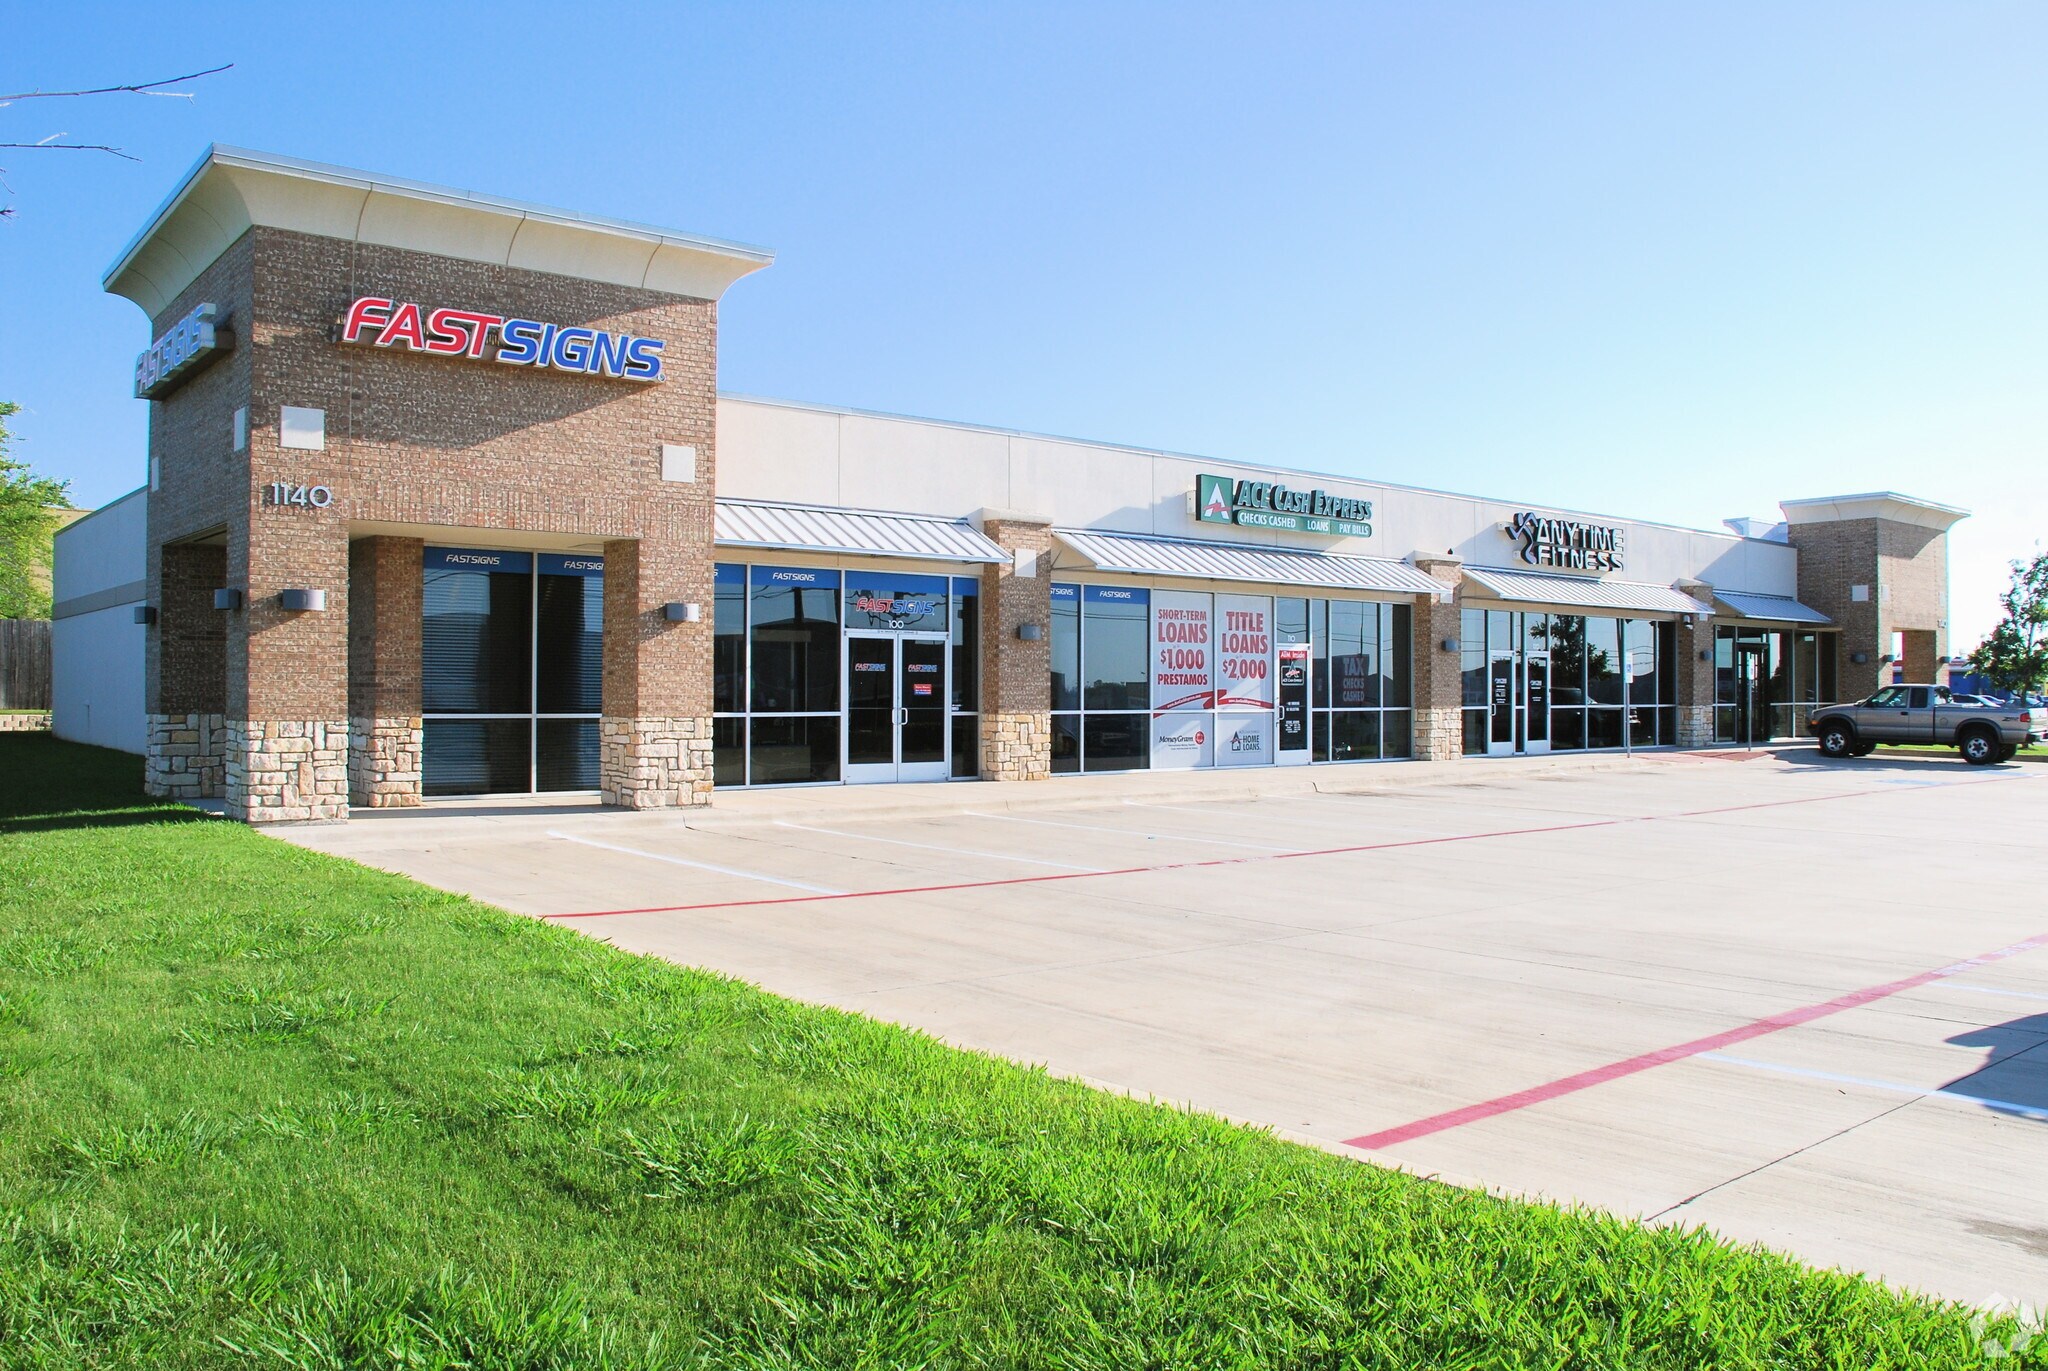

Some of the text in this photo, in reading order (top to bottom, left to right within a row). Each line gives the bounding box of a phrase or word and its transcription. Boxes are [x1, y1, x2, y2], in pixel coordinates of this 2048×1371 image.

[343, 297, 666, 382] FASTSIGNS
[272, 482, 332, 507] 1140
[1237, 480, 1272, 508] ACE
[1239, 511, 1369, 535] CHECKS CASHED LOANS PAY BILLS
[1537, 518, 1624, 551] ANYTIME
[446, 554, 500, 565] FASTSIGNS
[564, 561, 604, 571] FASTSIG
[1538, 545, 1624, 571] FITNESS
[772, 572, 815, 581] FASTSIGNS
[1050, 587, 1074, 596] STSIGNS
[1099, 590, 1132, 599] FASTSIGNS
[856, 598, 935, 615] FASTSIGNS
[1158, 609, 1207, 621] SHORT-TERM
[888, 620, 904, 629] 100
[1226, 611, 1264, 632] TITLE
[1158, 622, 1208, 643] LOANS
[1222, 633, 1269, 654] LOANS
[1160, 648, 1205, 671] $1,000
[1343, 657, 1365, 676] TAX
[1222, 659, 1267, 680] $2,000
[1157, 673, 1208, 686] PRESTAMOS
[1343, 678, 1364, 689] CHECKS
[1343, 690, 1364, 702] CASHED
